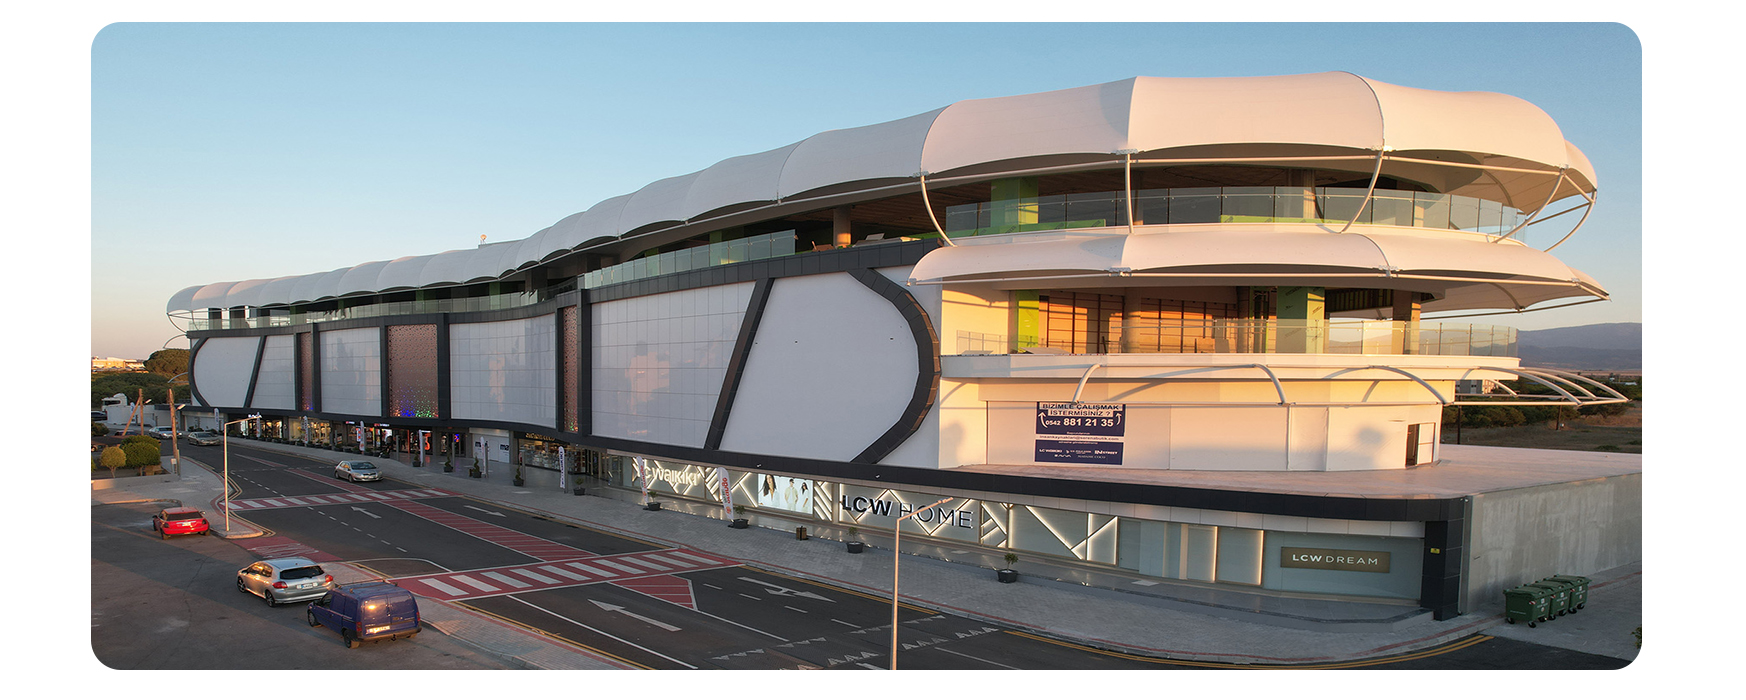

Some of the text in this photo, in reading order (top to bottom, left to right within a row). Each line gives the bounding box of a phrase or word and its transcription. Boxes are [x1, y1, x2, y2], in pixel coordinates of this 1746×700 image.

[1063, 418, 1082, 426] 881
[1085, 418, 1097, 427] 21
[1101, 419, 1114, 427] 35
[842, 495, 974, 529] LCW HOME
[1292, 554, 1378, 565] LCW DREAM
